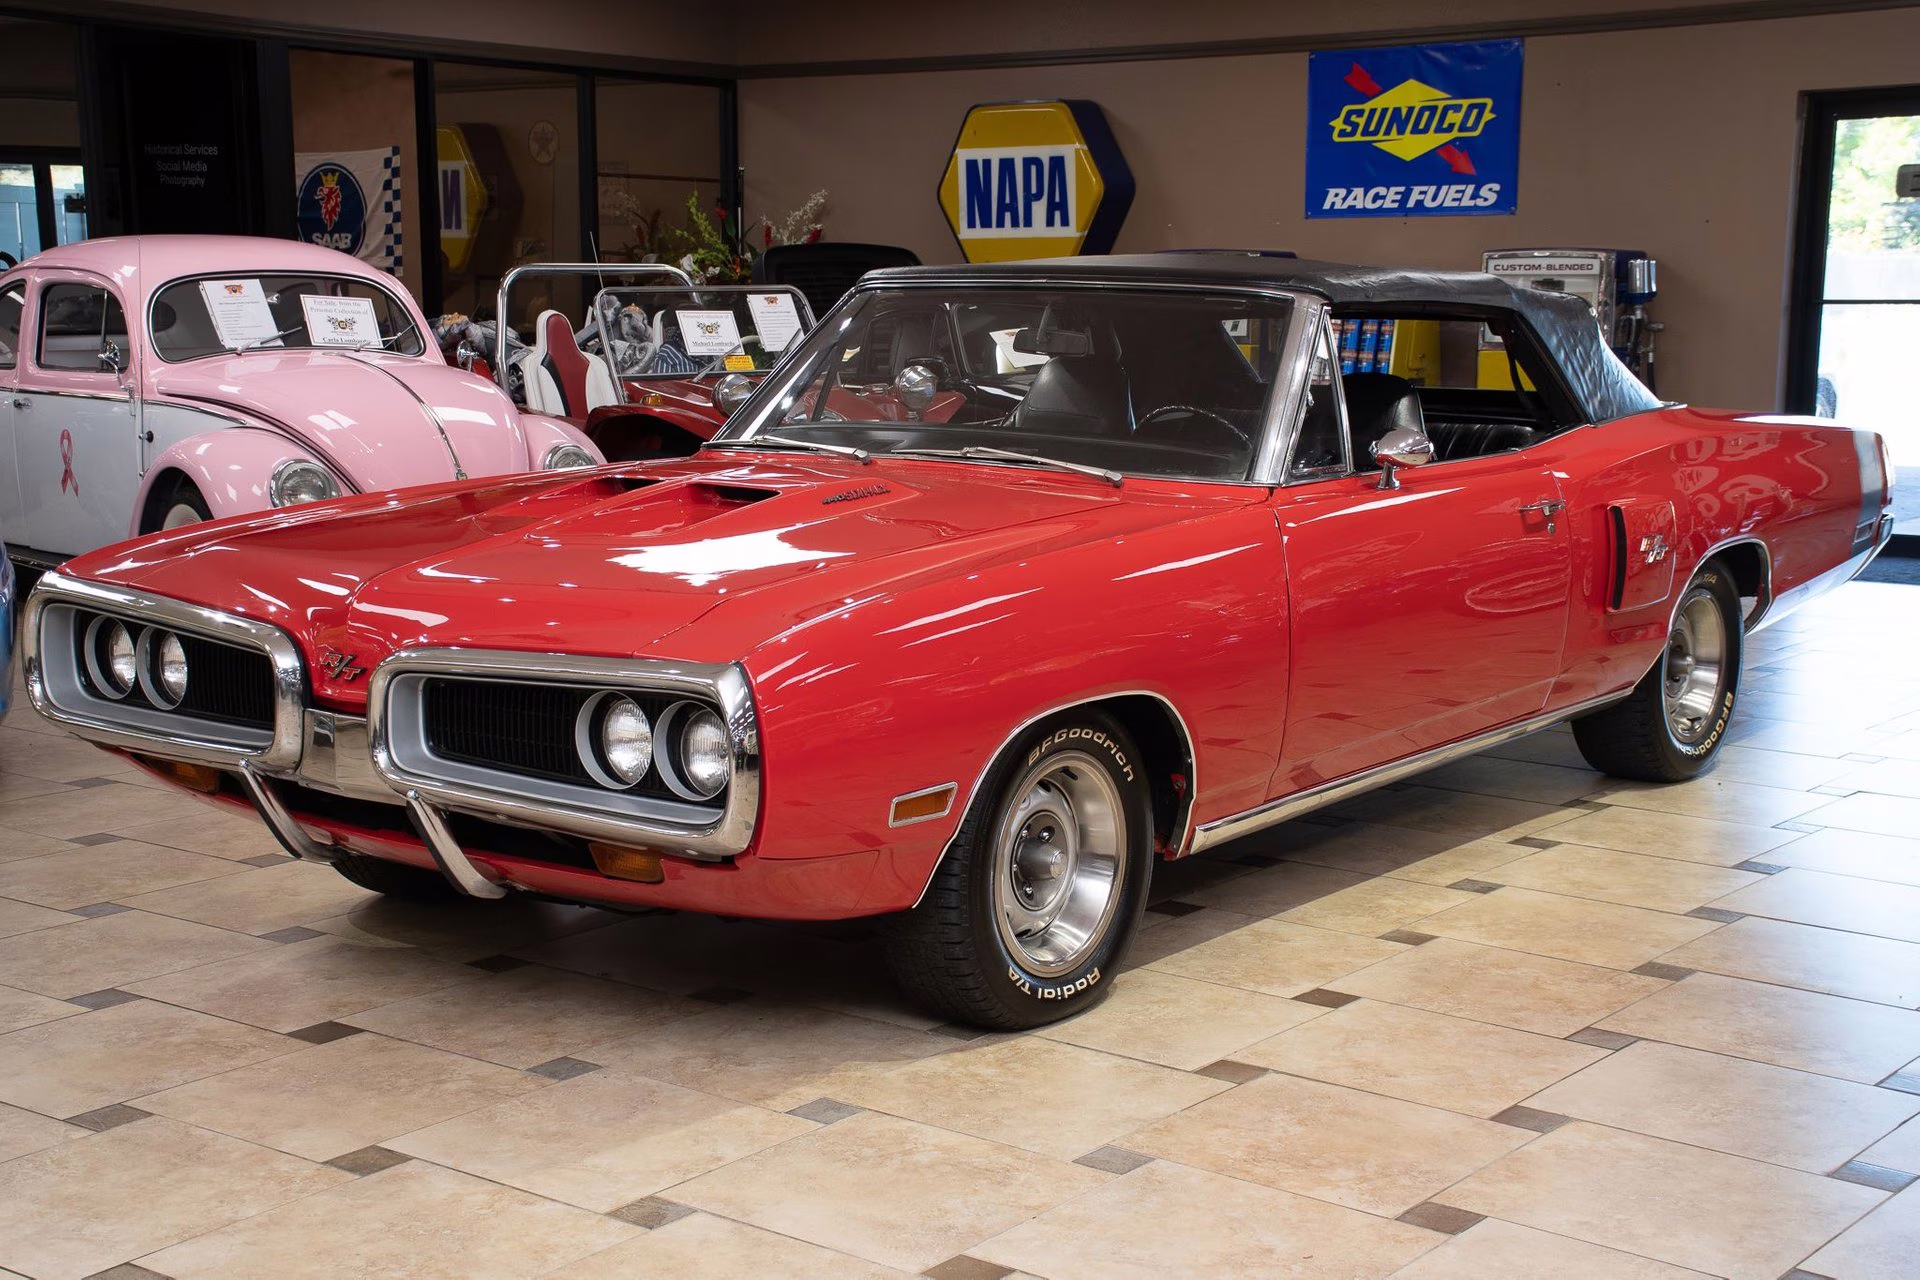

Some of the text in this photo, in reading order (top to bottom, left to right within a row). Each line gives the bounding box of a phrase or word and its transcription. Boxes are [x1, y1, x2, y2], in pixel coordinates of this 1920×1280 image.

[1338, 102, 1487, 138] SUNOCO
[144, 143, 218, 155] Historical Services
[155, 159, 208, 172] Social Media
[160, 173, 206, 188] Photography
[965, 155, 1070, 229] NAPA
[1322, 183, 1501, 210] RACE FUELS
[312, 232, 353, 249] SAAB
[1493, 263, 1594, 272] CUSTOM-BLENDED
[320, 652, 365, 680] R/T
[1028, 728, 1135, 782] BFGoodrich
[1008, 965, 1102, 1000] Radial T/A
